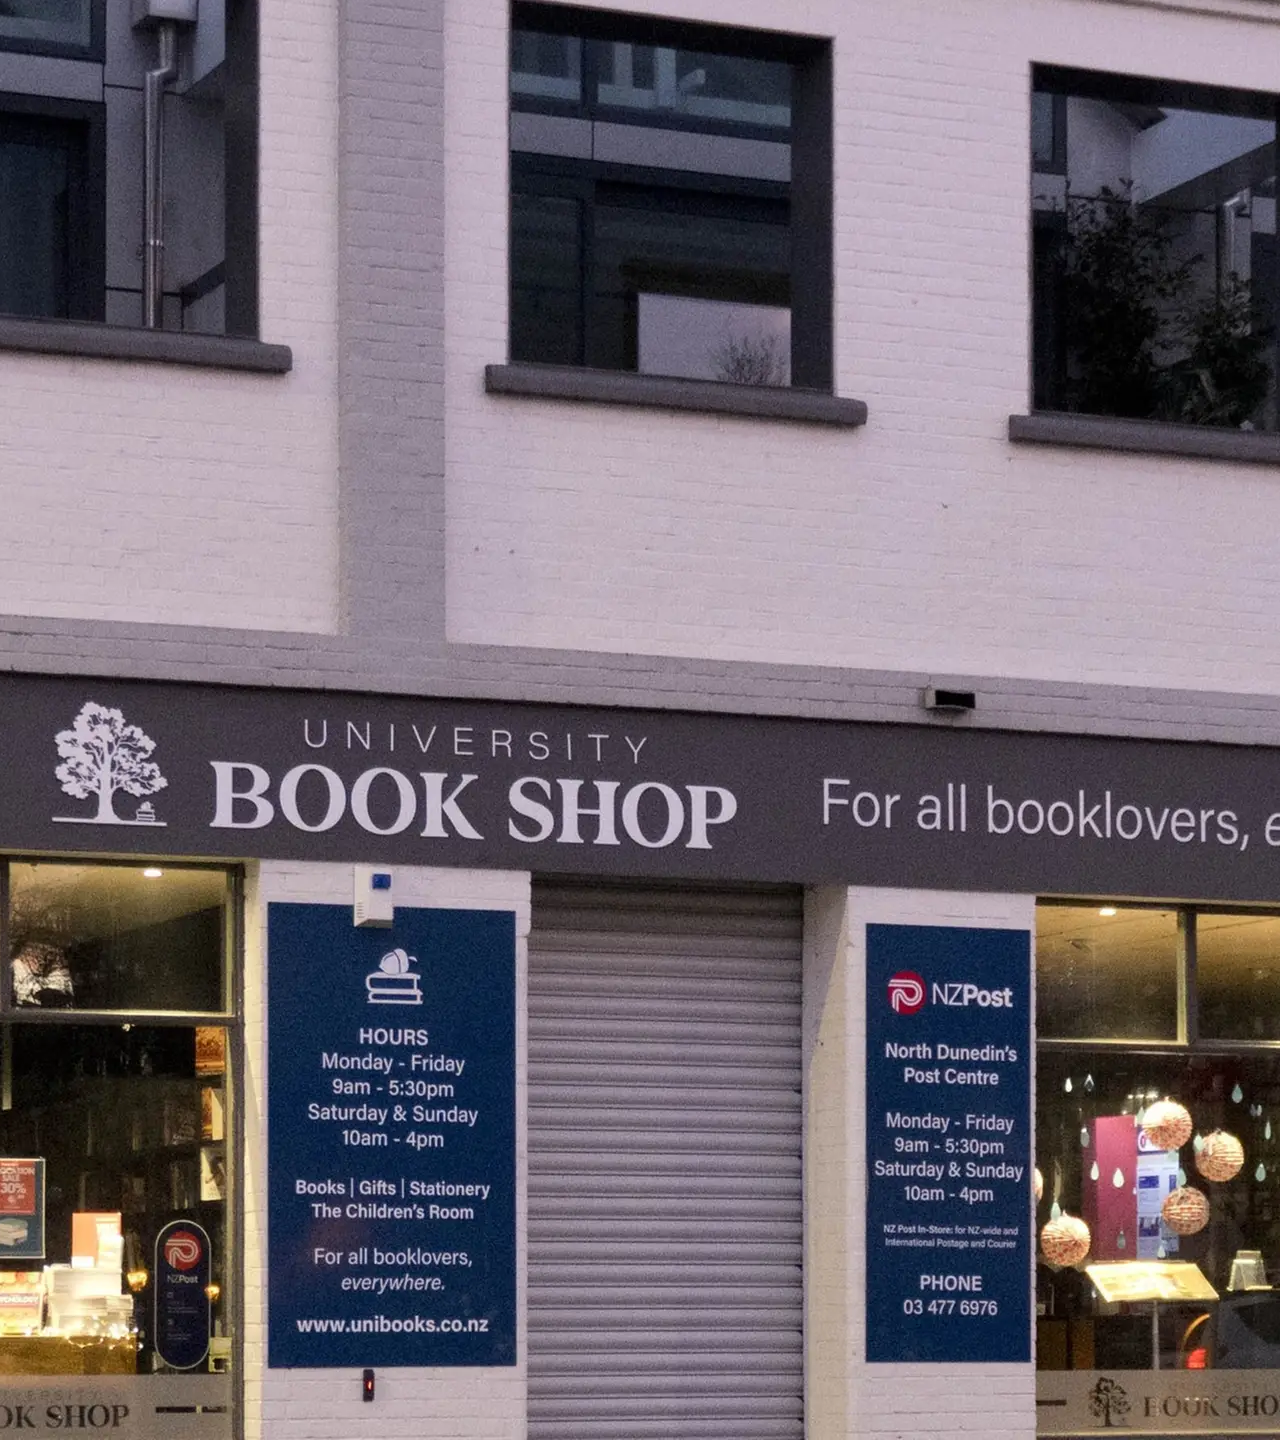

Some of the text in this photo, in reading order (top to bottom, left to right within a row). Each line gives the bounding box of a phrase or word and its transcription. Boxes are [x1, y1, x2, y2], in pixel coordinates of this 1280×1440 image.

[303, 718, 650, 765] UNIVERSITY
[209, 760, 738, 850] BOOK SHOP
[822, 777, 900, 828] For
[916, 783, 968, 833] all
[986, 785, 1251, 850] booklovers,
[932, 983, 1013, 1008] NZPost
[359, 1028, 429, 1046] HOURS
[885, 1042, 1018, 1062] North Dunedin’s
[321, 1052, 393, 1075] Monday
[411, 1054, 466, 1077] Friday
[903, 1067, 999, 1085] Post Centre
[332, 1078, 371, 1096] 9am
[389, 1080, 455, 1101] 5:30pm
[308, 1103, 479, 1128] Saturday & Sunday
[886, 1112, 950, 1132] Monday
[965, 1114, 1015, 1133] Friday
[342, 1129, 388, 1147] 10am
[405, 1130, 445, 1150] 4pm
[894, 1137, 930, 1153] 9am
[945, 1138, 1005, 1157] 5:30pm
[874, 1160, 1024, 1183] Saturday & Sunday
[0, 1182, 27, 1194] 30%
[295, 1179, 345, 1196] Books
[359, 1179, 397, 1197] Gifts
[409, 1180, 490, 1200] Stationery
[904, 1185, 945, 1202] 10am
[959, 1186, 994, 1205] 4pm
[311, 1203, 475, 1220] The Children’s Room
[883, 1225, 896, 1234] NZ
[897, 1225, 916, 1235] Post
[954, 1225, 966, 1235] for
[967, 1226, 1002, 1236] NZ-wide
[1003, 1226, 1019, 1236] and
[885, 1238, 1017, 1249] International Postage and Courier
[314, 1248, 473, 1268] For all booklovers,
[167, 1274, 199, 1284] NZPost
[341, 1274, 446, 1295] everywhere.
[920, 1275, 983, 1292] PHONE
[903, 1299, 998, 1317] 03 477 6976
[297, 1315, 489, 1334] www.unibooks.co.nz
[45, 1404, 130, 1428] SHOP
